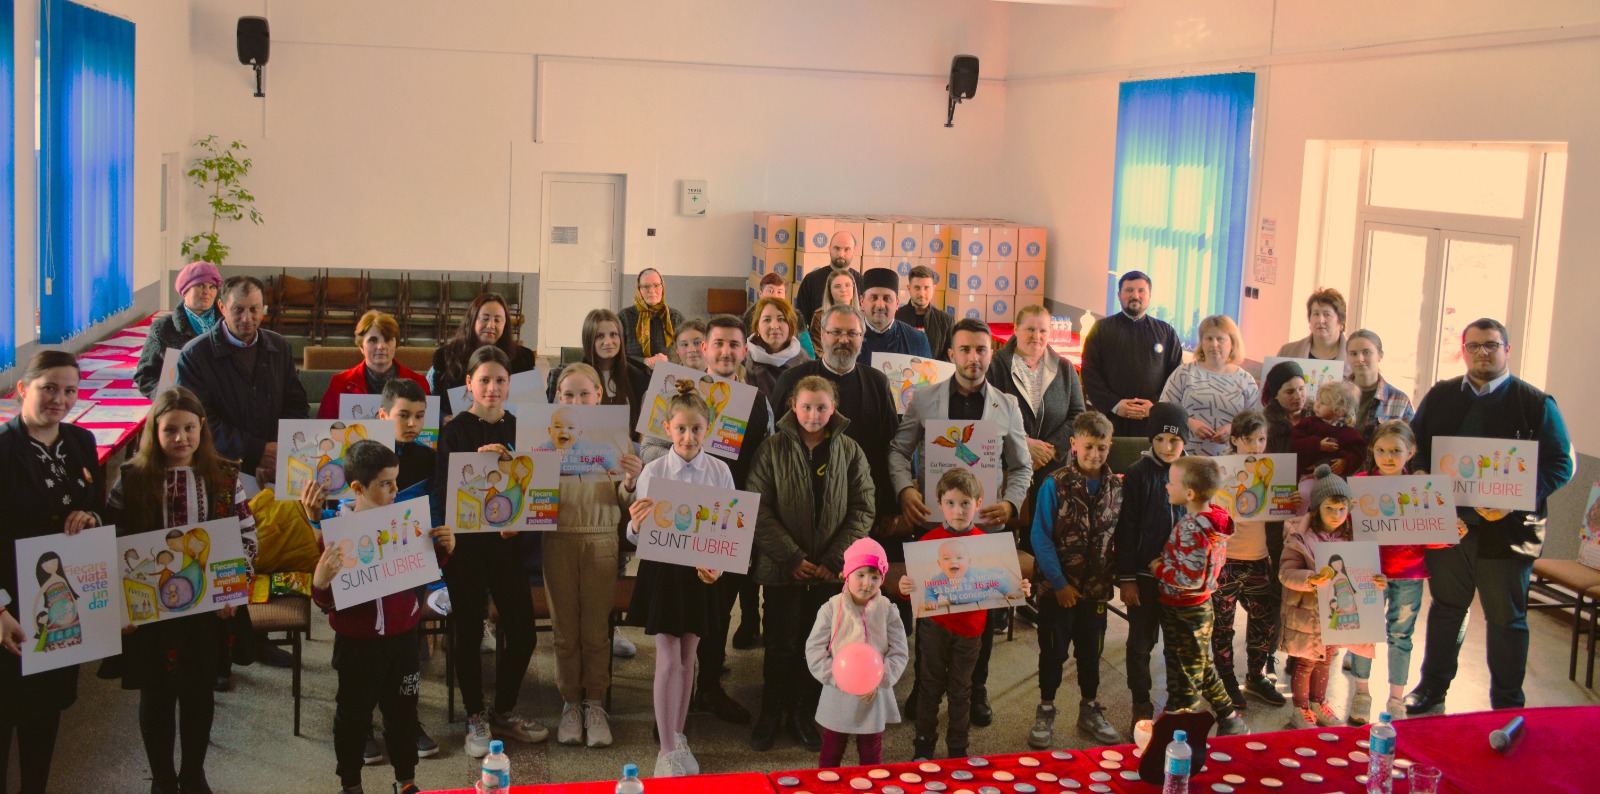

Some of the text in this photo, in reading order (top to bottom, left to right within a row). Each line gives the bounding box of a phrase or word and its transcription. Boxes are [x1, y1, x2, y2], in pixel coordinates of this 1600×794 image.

[1163, 424, 1179, 435] FBI
[592, 455, 605, 465] zile
[1478, 482, 1523, 497] IUBIRE
[1361, 517, 1446, 533] SUNT IUBIRE
[648, 529, 739, 558] SUNT IUBIRE
[63, 561, 107, 576] Fiecare
[219, 569, 237, 579] copil
[340, 552, 426, 591] SUNT IUBIRE
[82, 580, 109, 593] este
[924, 578, 948, 587] Inima
[974, 581, 984, 590] 16
[986, 579, 1000, 589] zile
[92, 590, 109, 600] un
[215, 592, 242, 603] poveste
[950, 593, 958, 602] la
[88, 597, 110, 611] dar
